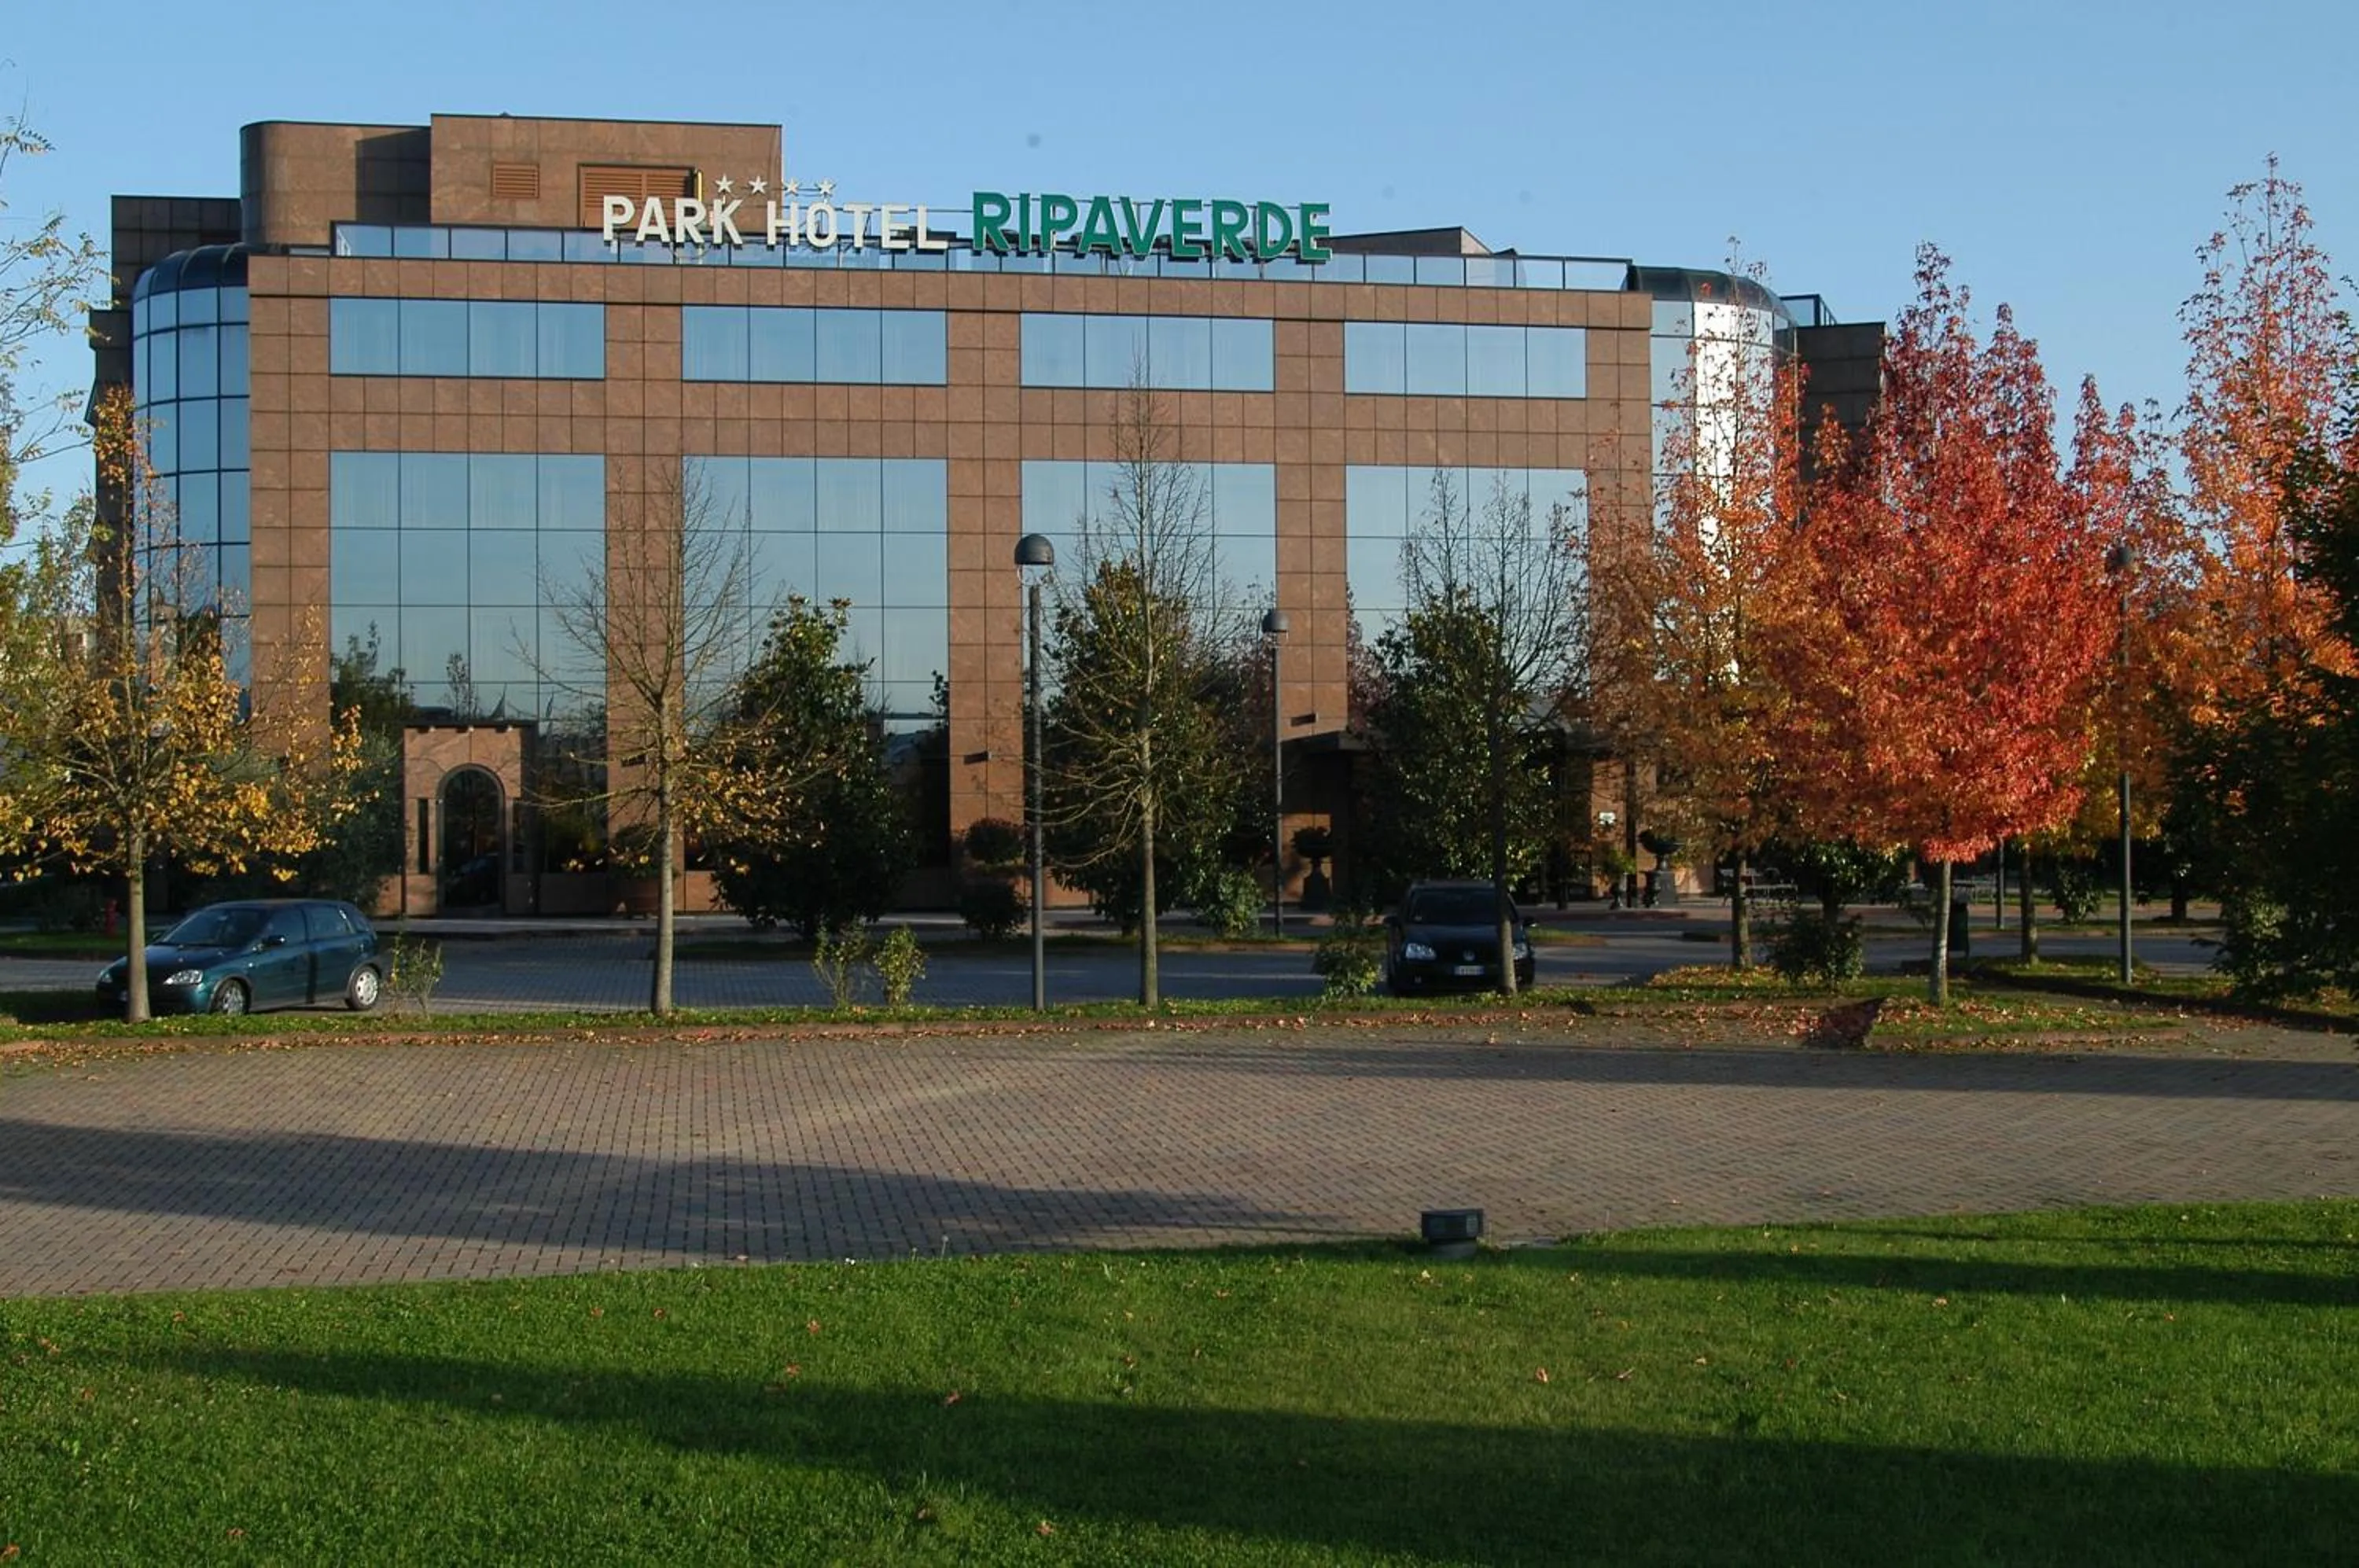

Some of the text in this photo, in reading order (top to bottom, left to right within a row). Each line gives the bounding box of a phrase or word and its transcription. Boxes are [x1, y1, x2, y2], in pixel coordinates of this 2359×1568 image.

[602, 191, 1333, 260] PARK HOTEL RIPAVERDE
